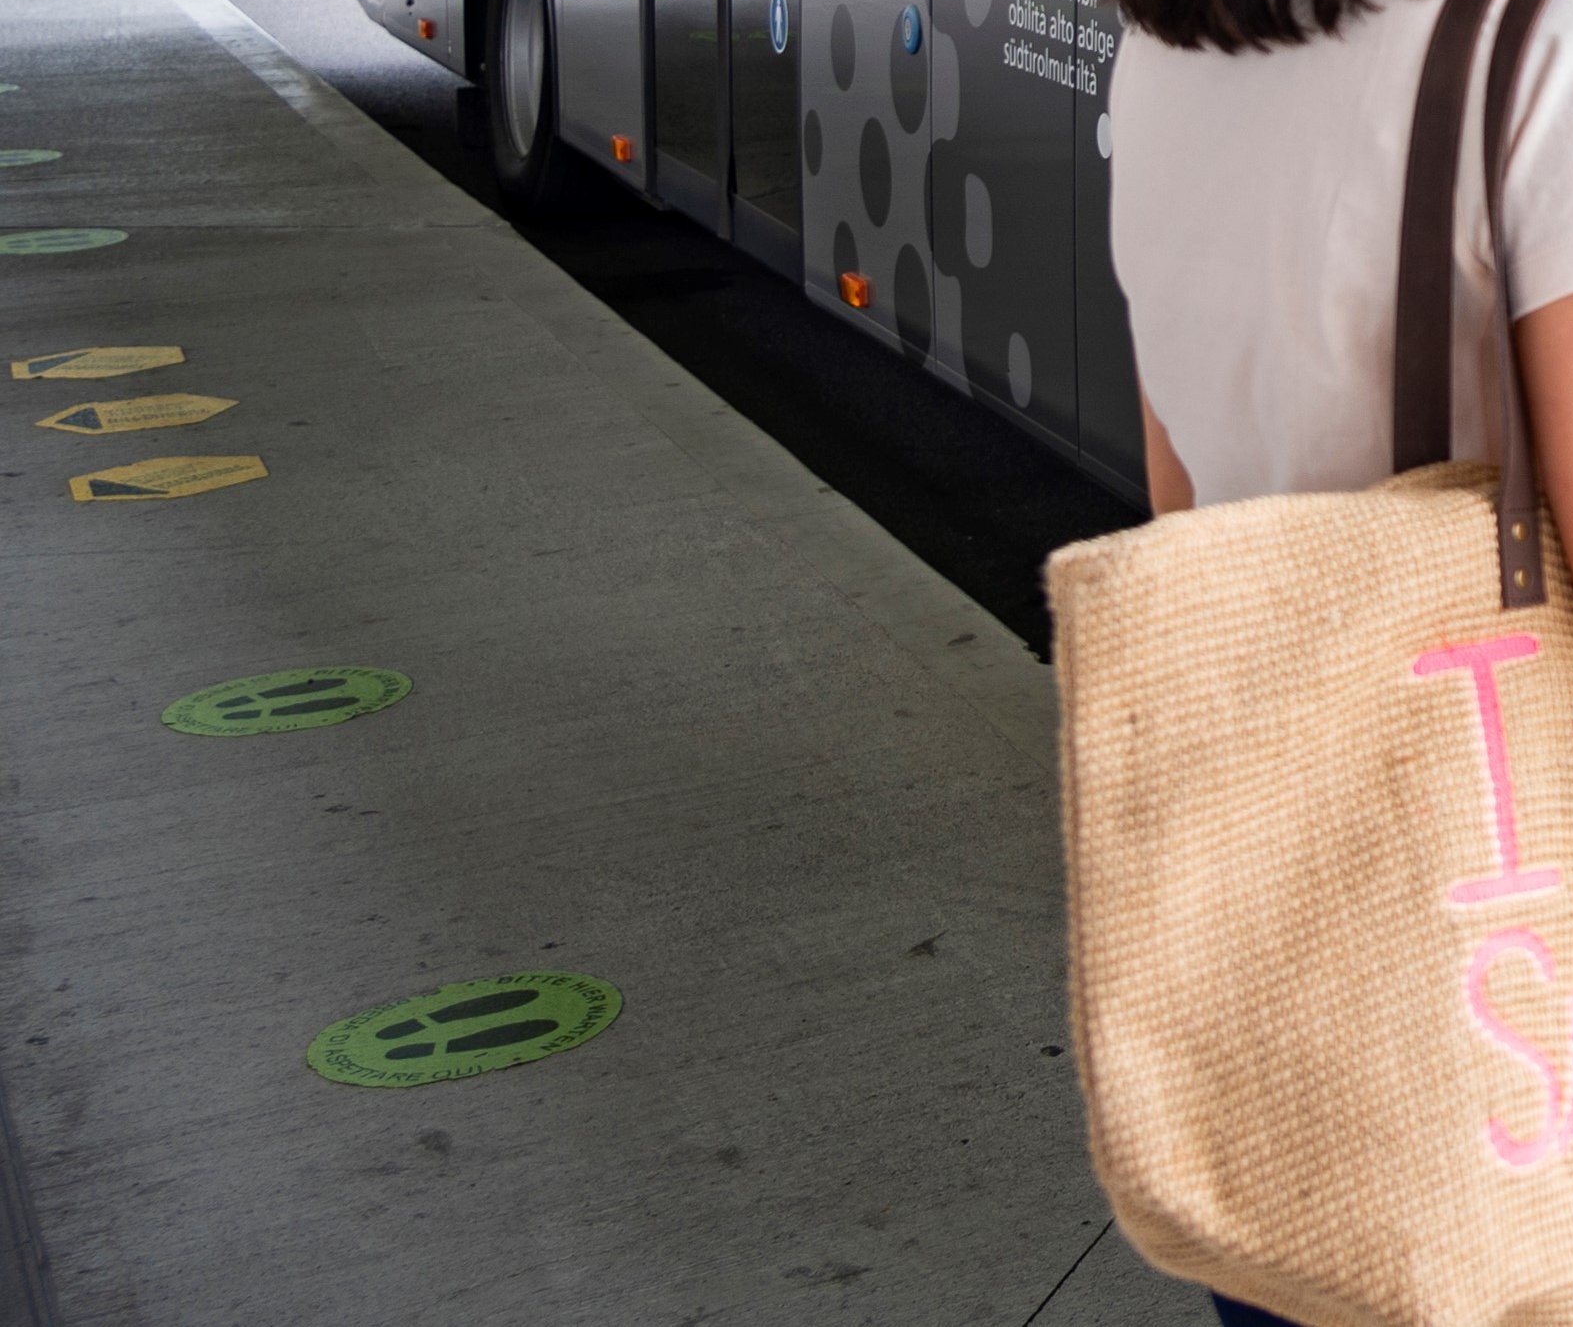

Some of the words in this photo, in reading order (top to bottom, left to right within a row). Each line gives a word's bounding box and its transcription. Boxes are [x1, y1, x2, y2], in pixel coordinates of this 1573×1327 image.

[1049, 9, 1074, 44] alto
[1078, 19, 1114, 63] adige
[1413, 633, 1562, 905] I
[498, 974, 572, 986] BITTE
[569, 981, 607, 1003] HIER
[540, 1003, 607, 1052] WARTEN
[324, 1049, 425, 1082] ASPETTARE
